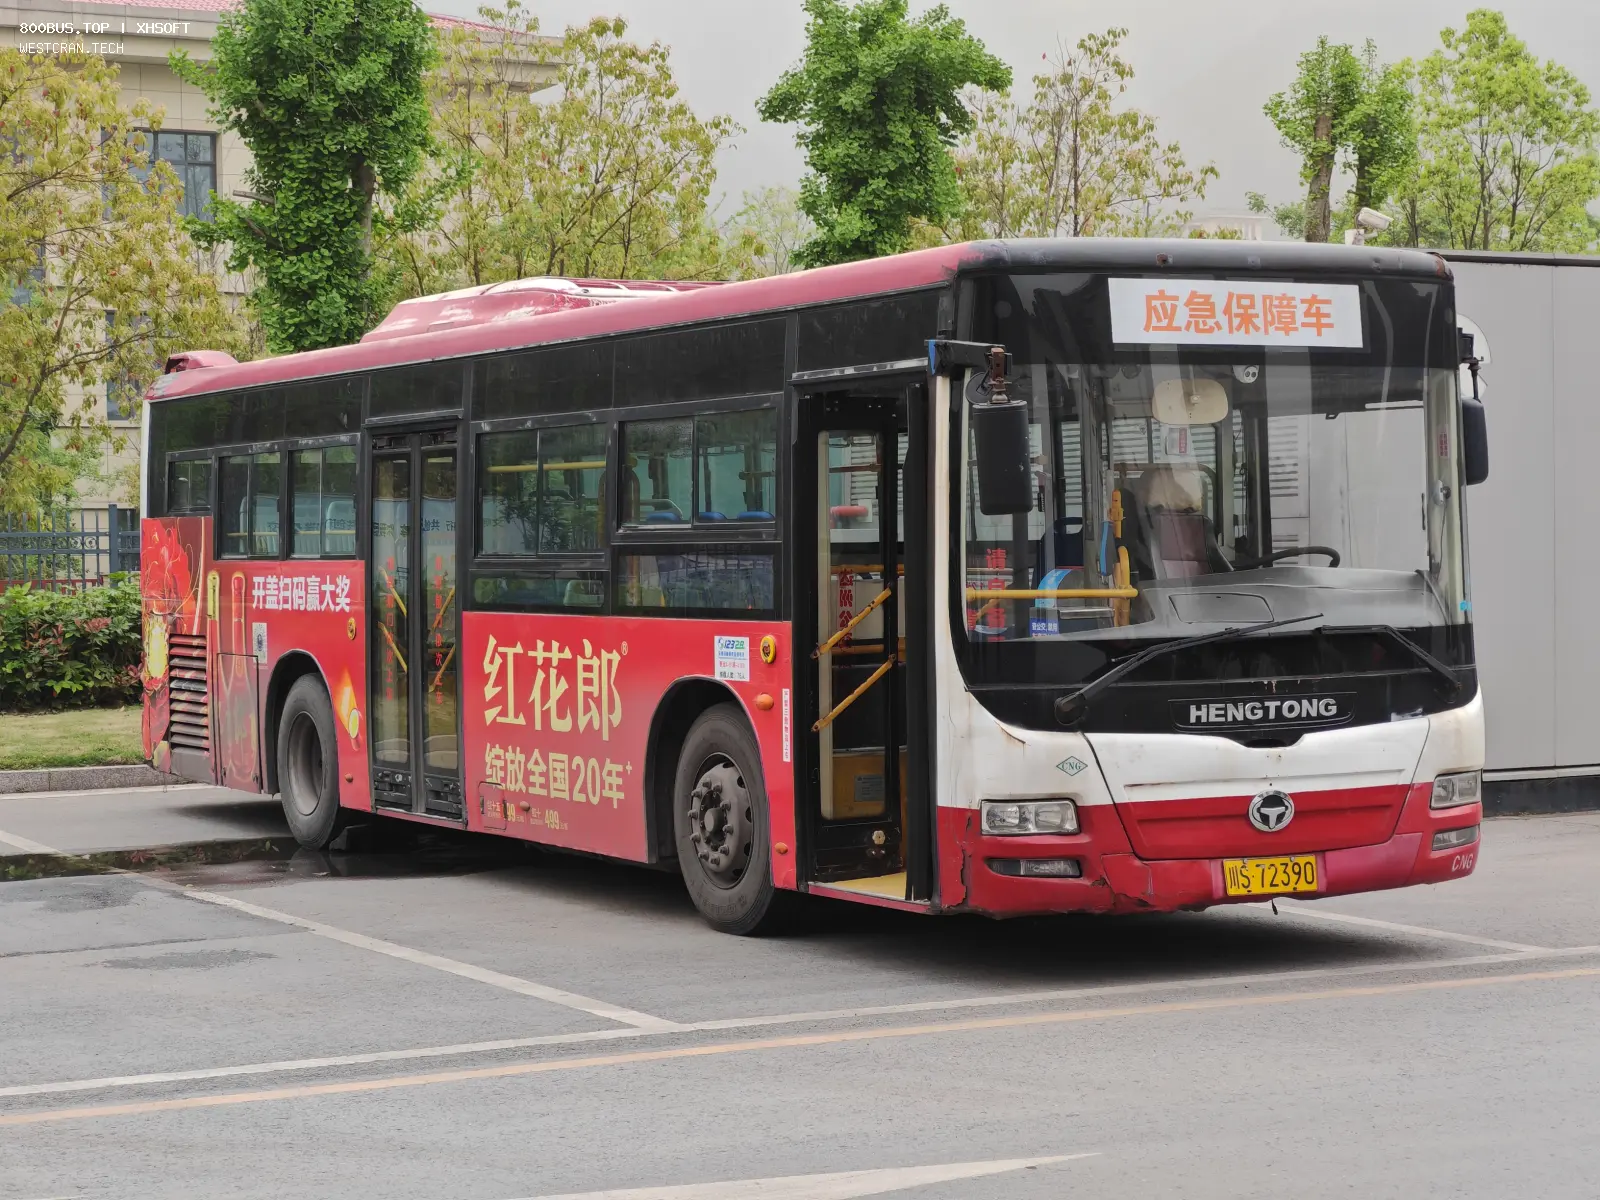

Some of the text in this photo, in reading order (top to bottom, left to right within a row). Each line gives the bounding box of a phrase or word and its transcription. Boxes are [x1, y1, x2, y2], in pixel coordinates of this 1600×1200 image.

[1143, 289, 1335, 337] 应急保障车
[252, 575, 351, 612] 开盖扫码赢大奖
[1189, 697, 1338, 725] HENGTONG
[1061, 761, 1082, 772] CNG
[503, 802, 516, 822] 99
[544, 809, 560, 830] 499
[1451, 853, 1474, 873] CNG
